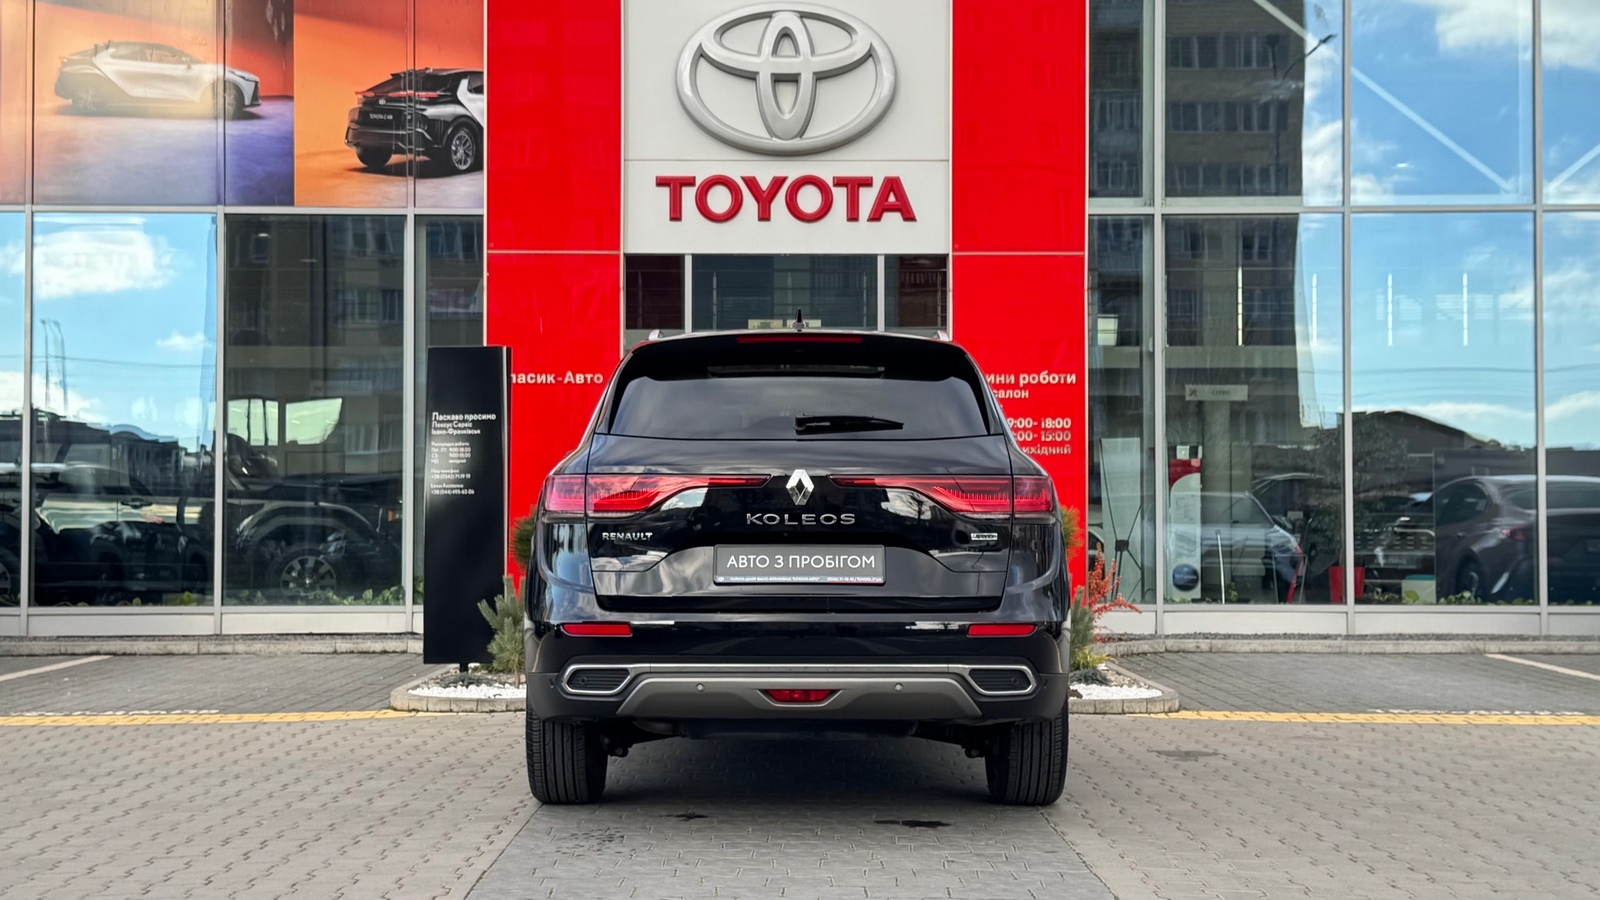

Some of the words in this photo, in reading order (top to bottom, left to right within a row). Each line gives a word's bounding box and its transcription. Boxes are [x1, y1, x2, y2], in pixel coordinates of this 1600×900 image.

[655, 174, 918, 223] TOYOTA
[1019, 369, 1077, 387] роботи
[464, 413, 496, 422] просимо
[1041, 417, 1071, 428] 18:00
[1041, 431, 1071, 442] 15:00
[746, 513, 856, 525] KOLEOS
[601, 532, 653, 541] RENAULT
[726, 555, 770, 568] АВТО
[773, 555, 784, 568] З
[788, 555, 875, 568] ПРОБІГОМ
